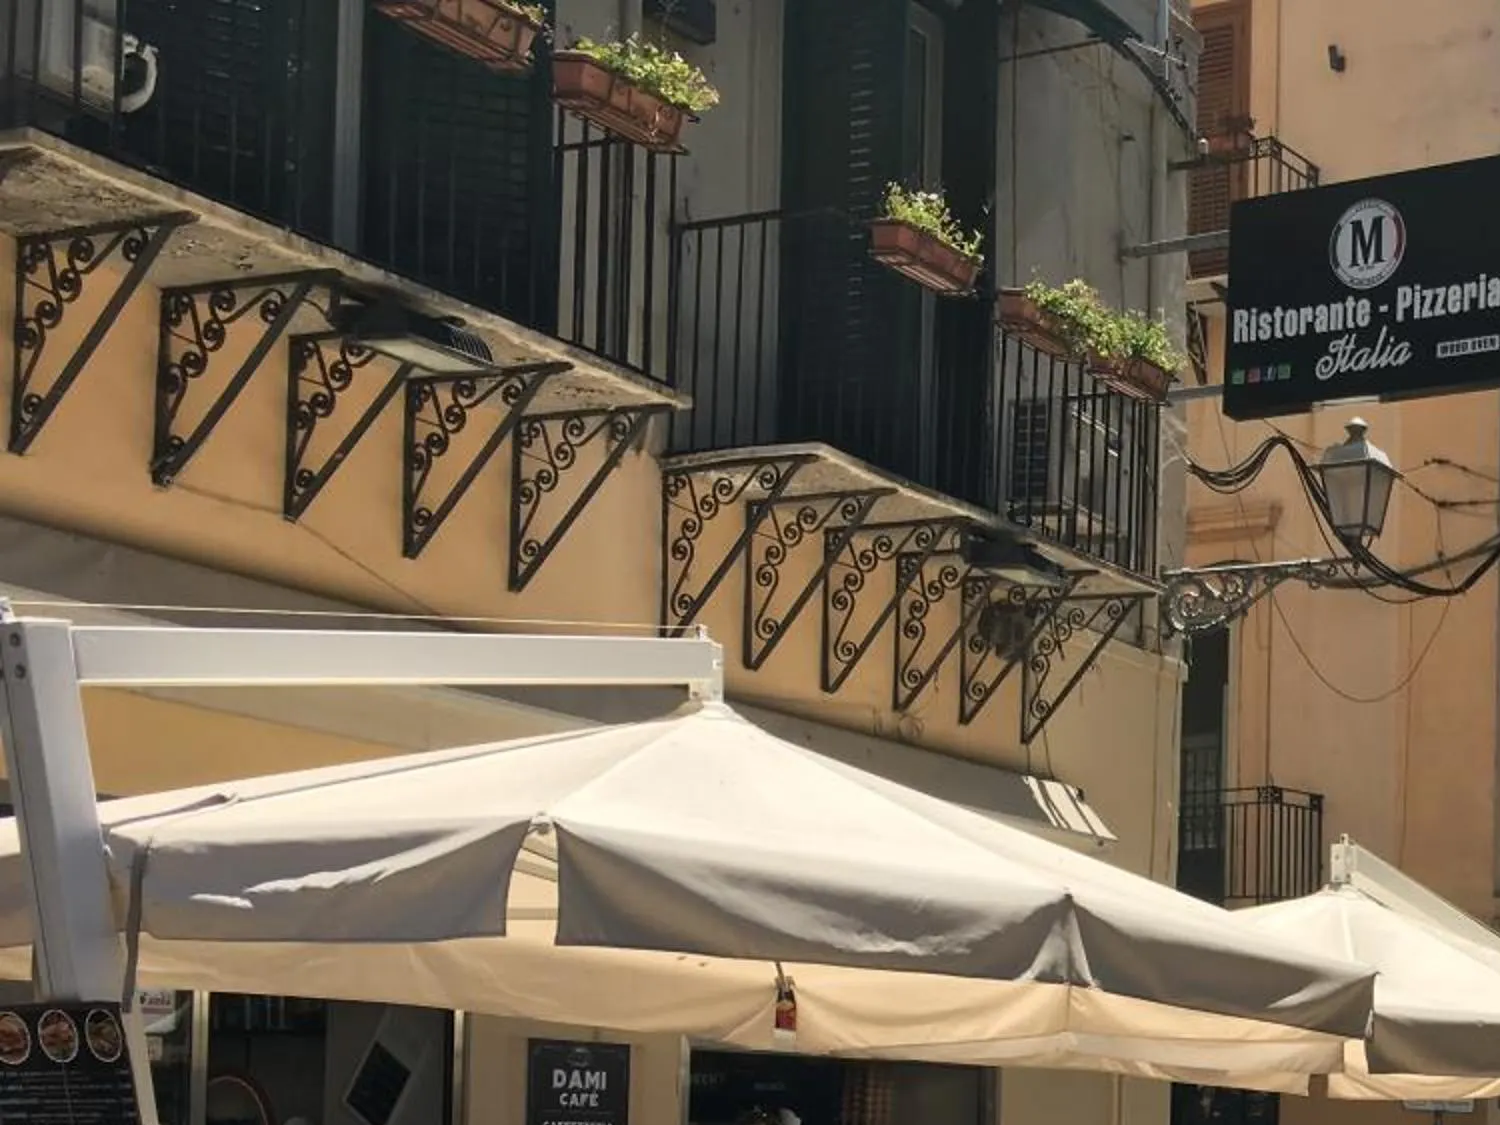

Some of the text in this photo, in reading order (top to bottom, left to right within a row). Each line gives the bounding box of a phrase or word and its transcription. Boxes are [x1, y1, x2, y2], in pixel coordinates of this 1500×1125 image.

[1349, 215, 1386, 268] M
[1232, 296, 1371, 343] Ristorante
[1315, 325, 1412, 380] Italia
[552, 1068, 607, 1090] DAMI
